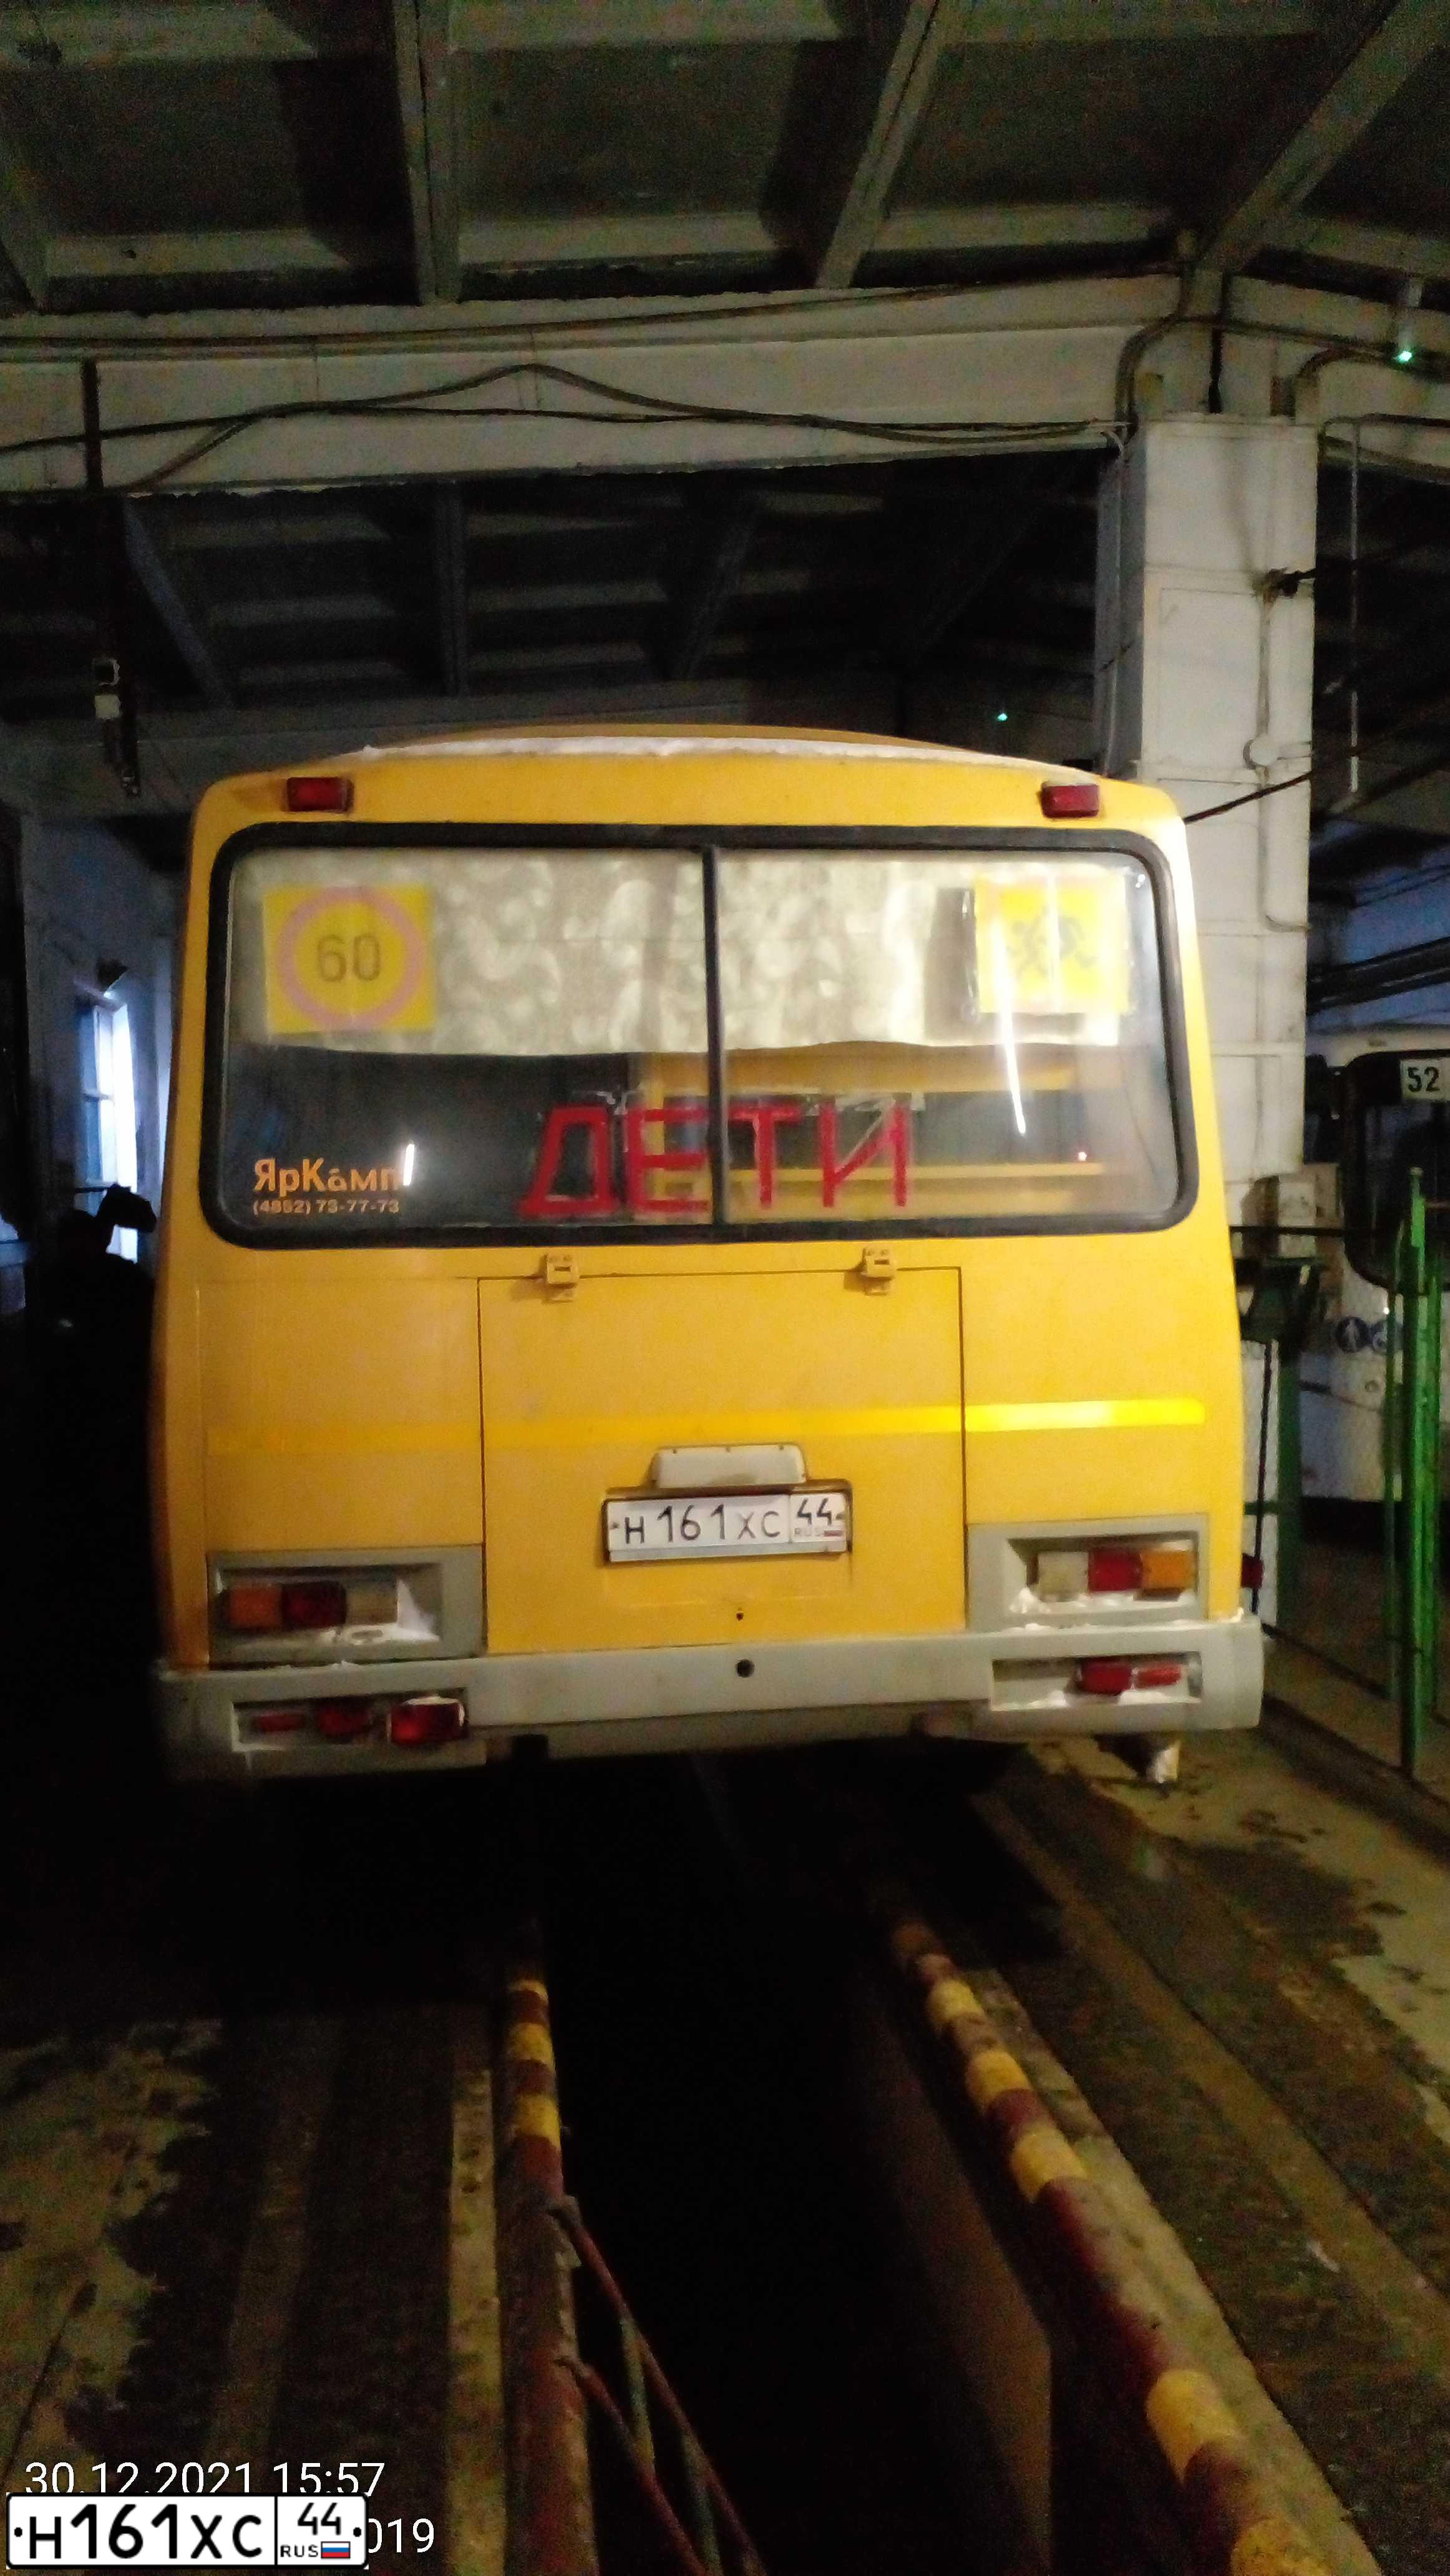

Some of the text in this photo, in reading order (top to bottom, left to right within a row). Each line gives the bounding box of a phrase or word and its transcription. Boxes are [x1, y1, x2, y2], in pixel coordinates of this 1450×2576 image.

[317, 934, 381, 983] 60
[1407, 1066, 1441, 1093] 52
[517, 1096, 908, 1217] ДЕТИ
[253, 1158, 401, 1198] ЯрКамп
[797, 1497, 833, 1526] 44
